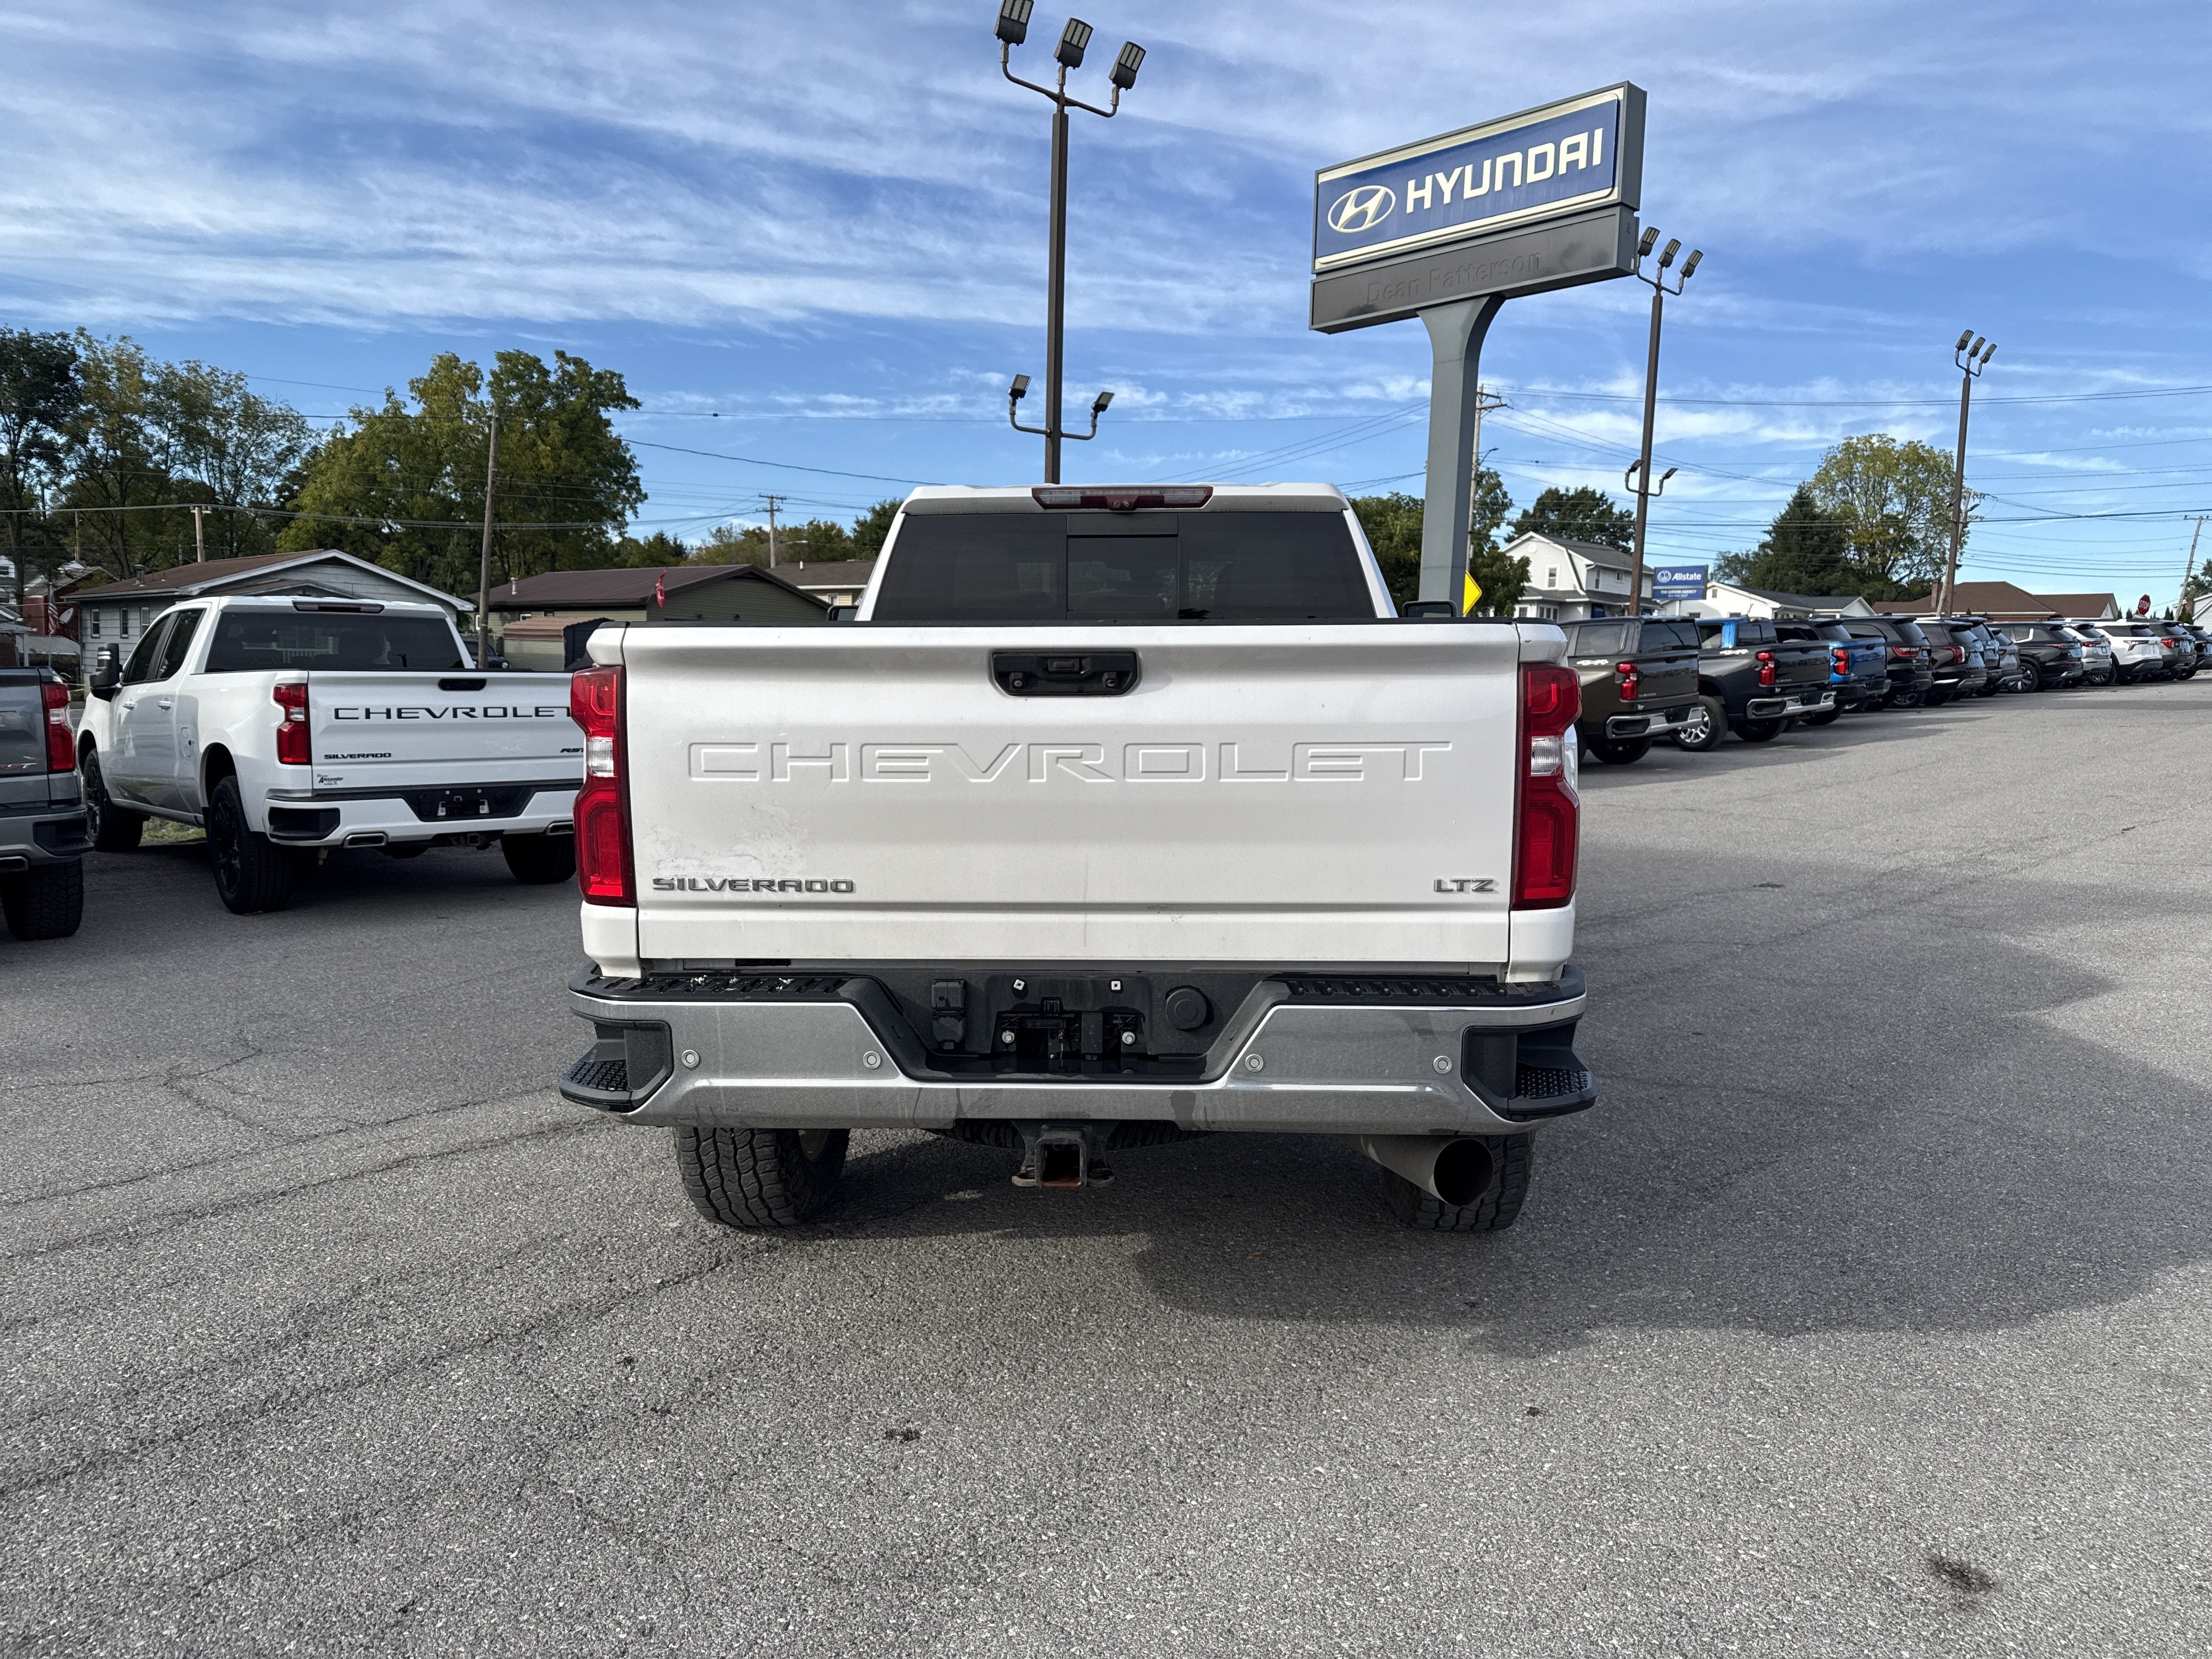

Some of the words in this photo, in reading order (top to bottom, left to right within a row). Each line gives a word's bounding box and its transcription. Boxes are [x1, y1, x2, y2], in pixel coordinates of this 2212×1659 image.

[1407, 128, 1603, 213] HYUNDAI
[1367, 279, 1418, 305] Dean
[1430, 252, 1541, 292] Patterson
[1672, 572, 1701, 581] Allstate
[2139, 600, 2150, 610] STOP
[689, 742, 1452, 783] CHEVROLET
[653, 877, 854, 892] SILVERADO
[1434, 878, 1494, 891] LTZ
